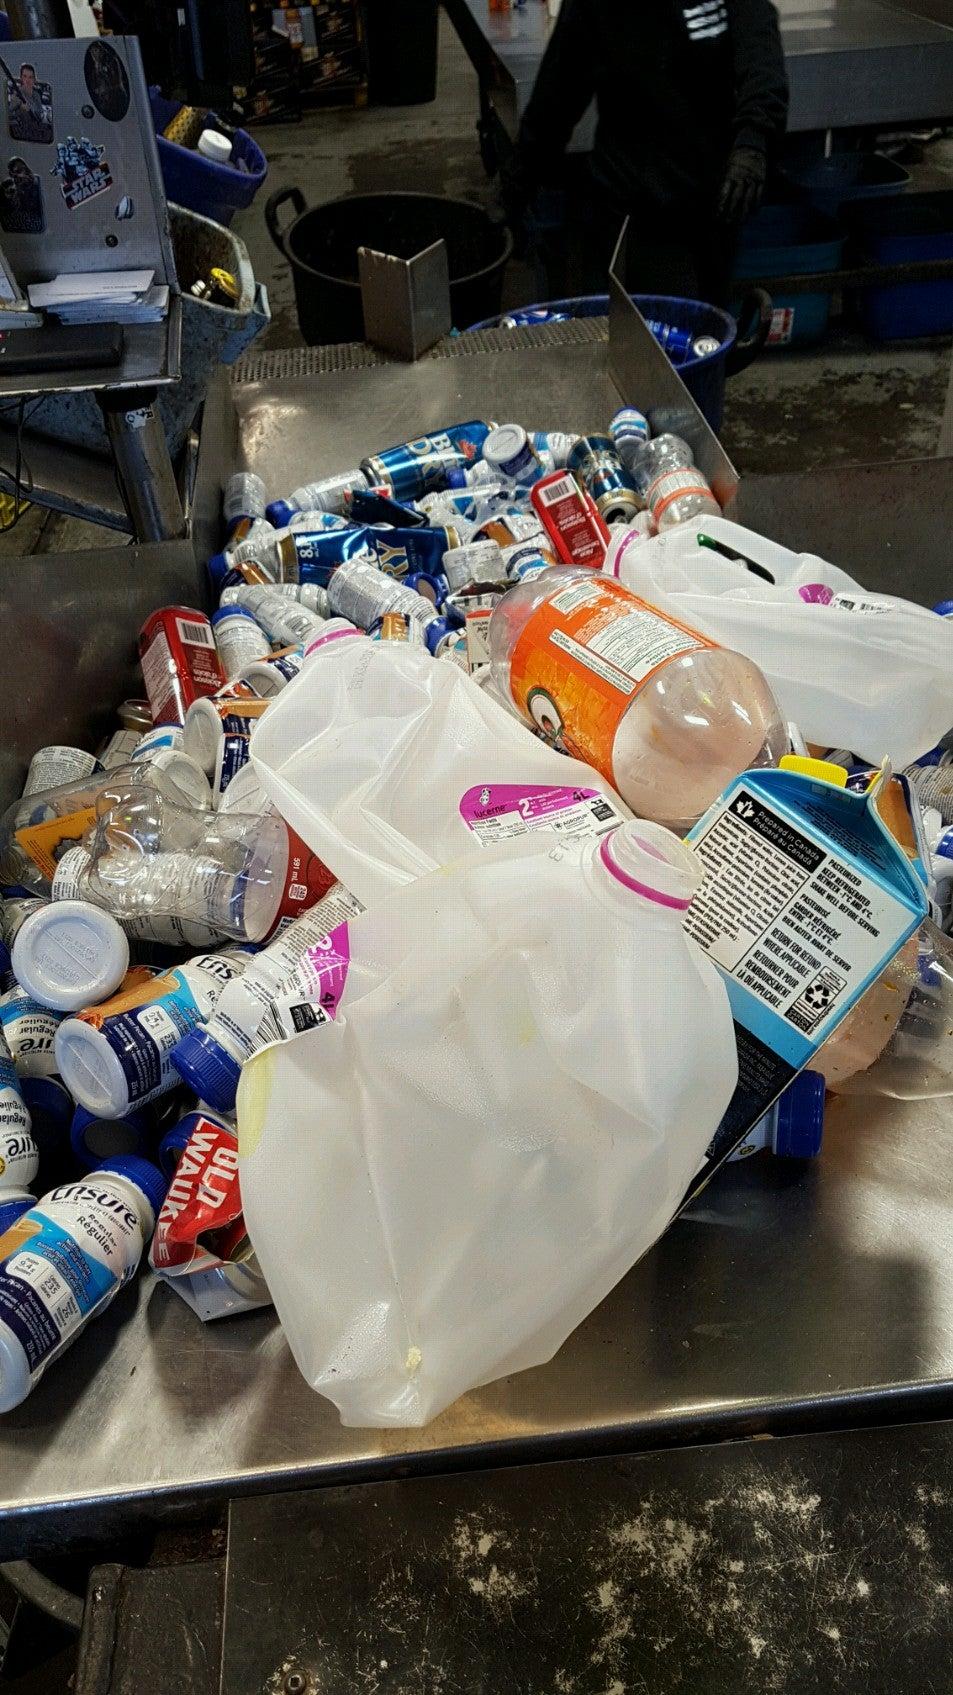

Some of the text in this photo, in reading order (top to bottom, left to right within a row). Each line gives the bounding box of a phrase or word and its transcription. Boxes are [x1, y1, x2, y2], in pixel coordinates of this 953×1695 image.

[64, 168, 110, 195] STAR
[72, 178, 113, 203] WARS
[473, 804, 507, 818] lucerne
[518, 799, 534, 817] 2
[572, 791, 590, 802] 4L
[751, 816, 813, 866] Préparé au Canada
[756, 810, 820, 861] Prepared in Canada
[291, 871, 298, 881] mL
[292, 857, 300, 868] 591
[827, 858, 862, 887] PASTEURIZED
[799, 892, 831, 919] PASTEURISÉ
[815, 872, 874, 920] BETWEEN -1°C AND 4°C.
[820, 866, 871, 907] KEEP REFRIGERATED
[787, 907, 834, 946] ENTRE -1°C ET 4°C.
[792, 901, 841, 940] GARDER RÉFRIGÉRÉ
[809, 880, 880, 938] SHAKE WELL BEFORE SERVING
[761, 936, 811, 978] WHERE APPLICABLE
[769, 926, 822, 971] RETURN FOR REFUND
[781, 915, 852, 972] BIEN AGITER AVANT DE SERVIR
[735, 967, 748, 980] LÀ
[750, 980, 783, 1008] APPLICABLE
[743, 959, 791, 999] REMBOURSEMENT
[752, 949, 785, 978] RETOURNER
[781, 971, 800, 989] POUR
[19, 1024, 55, 1036] Regular
[133, 1024, 146, 1041] Pecan
[157, 1118, 218, 1262] WAUKEE
[197, 1146, 240, 1210] OLD
[76, 1216, 114, 1257] Régulier
[88, 1212, 118, 1247] Regular
[24, 1290, 44, 1315] Pacanes
[38, 1313, 47, 1322] au
[43, 1278, 58, 1295] 235
[59, 1306, 72, 1319] 26
